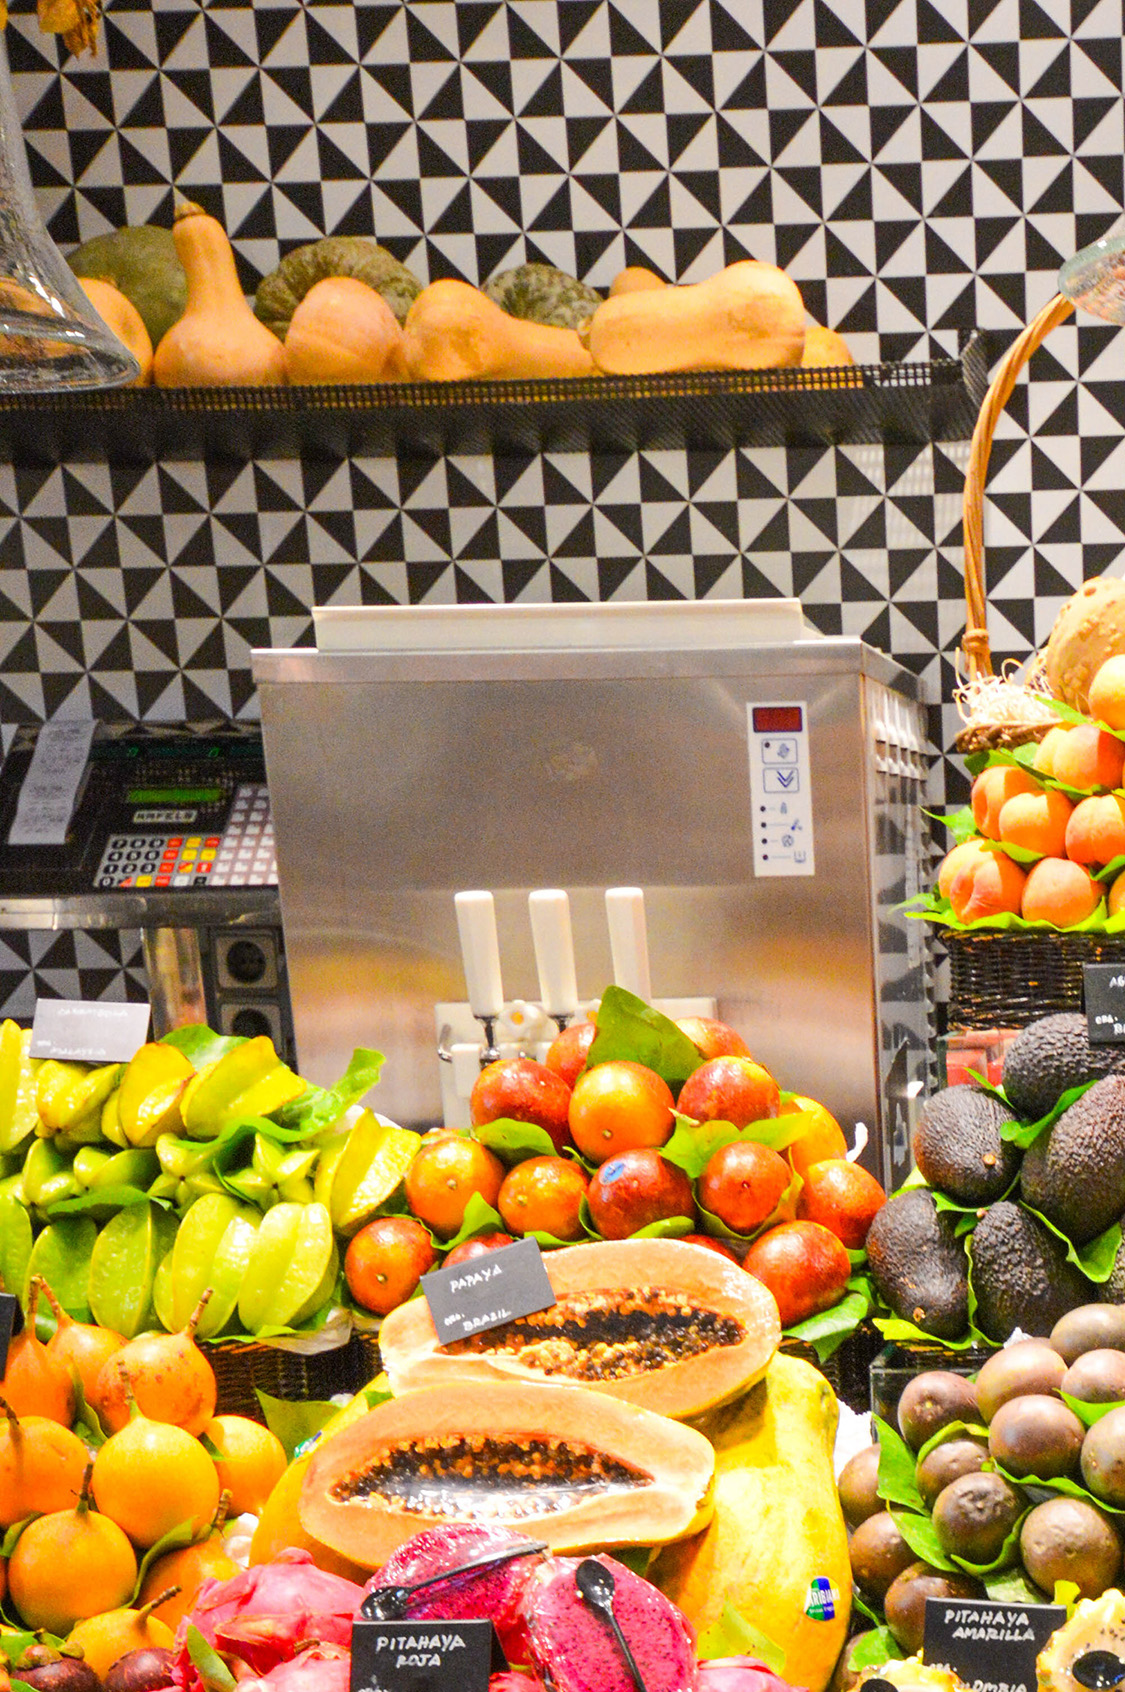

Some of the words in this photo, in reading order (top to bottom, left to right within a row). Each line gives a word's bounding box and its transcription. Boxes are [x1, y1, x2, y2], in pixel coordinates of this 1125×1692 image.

[449, 1264, 503, 1294] PAPAYA
[944, 1609, 1030, 1628] PITAHAYA
[951, 1626, 1036, 1641] AMARILLA
[375, 1634, 467, 1654] PITAHAYA
[395, 1653, 441, 1669] ROJA
